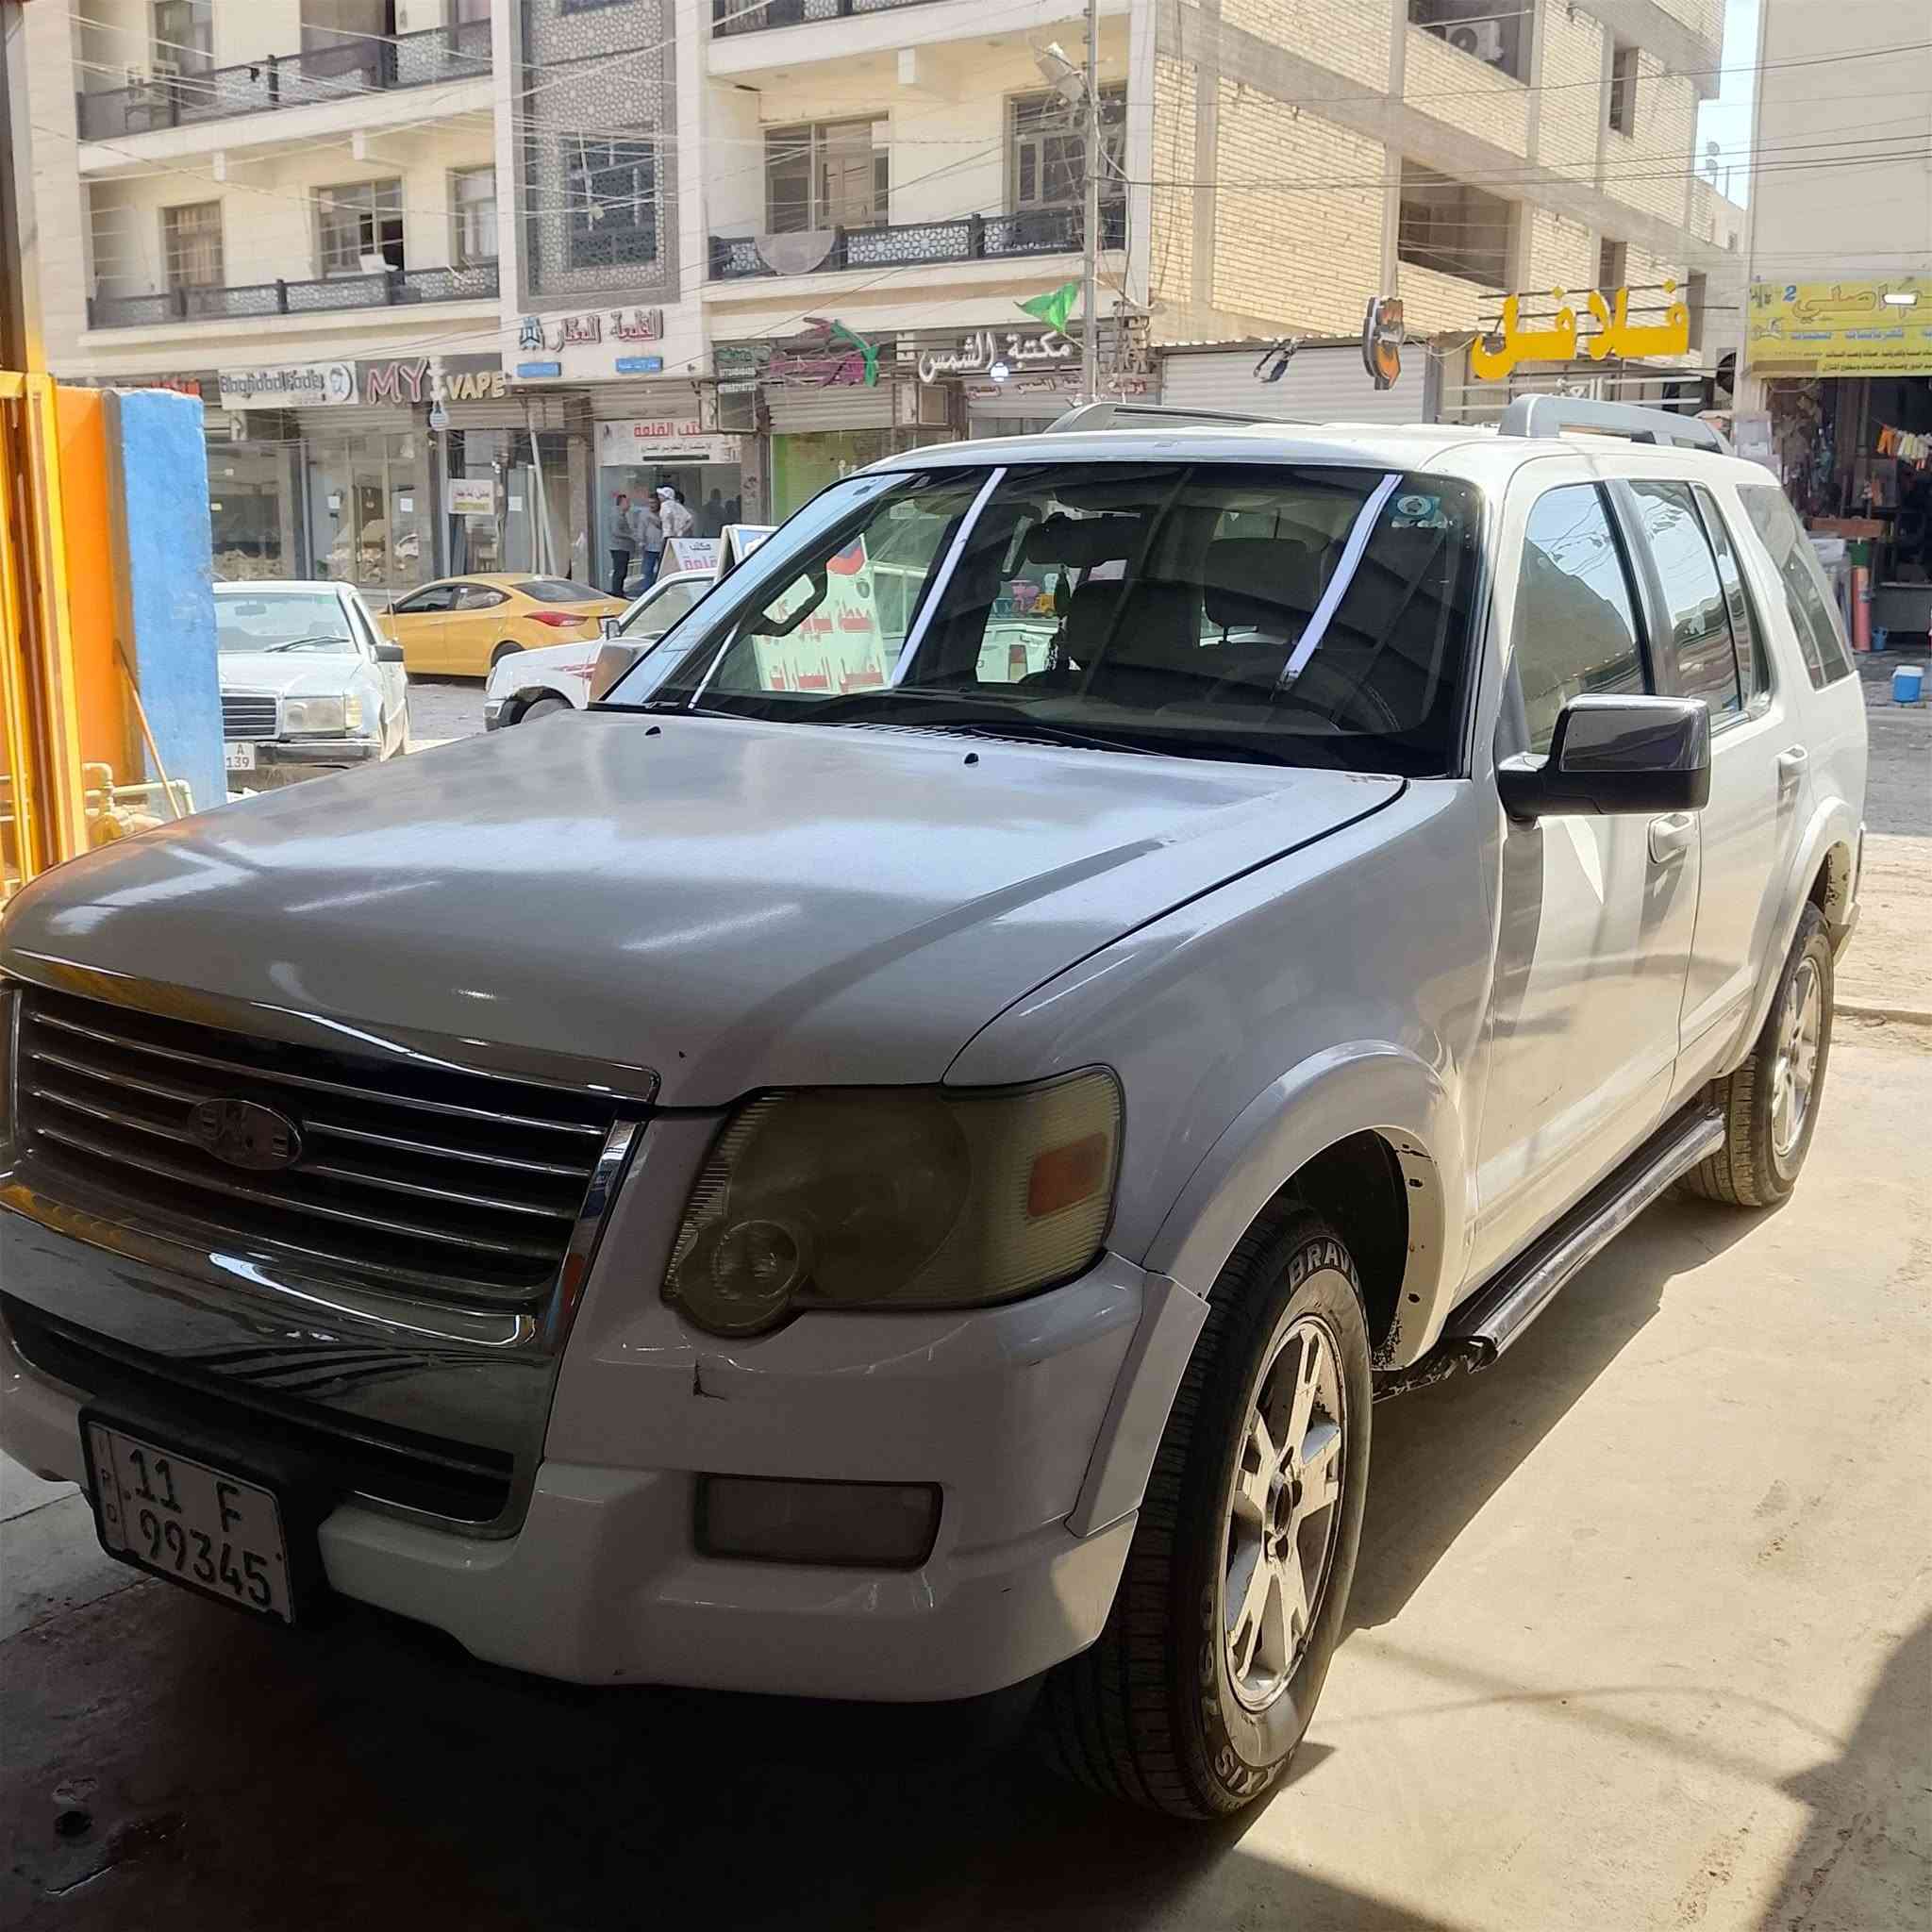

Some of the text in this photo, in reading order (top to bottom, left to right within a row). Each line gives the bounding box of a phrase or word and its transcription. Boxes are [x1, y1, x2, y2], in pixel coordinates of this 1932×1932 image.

[1006, 330, 1073, 370] مكتبة
[1472, 278, 1690, 382] فلافل
[366, 356, 506, 405] MY VAPE
[918, 330, 998, 383] الشمس
[633, 421, 674, 438] القلعة
[225, 756, 250, 768] 139
[128, 1448, 242, 1532] 11 F
[139, 1508, 272, 1607] 99345
